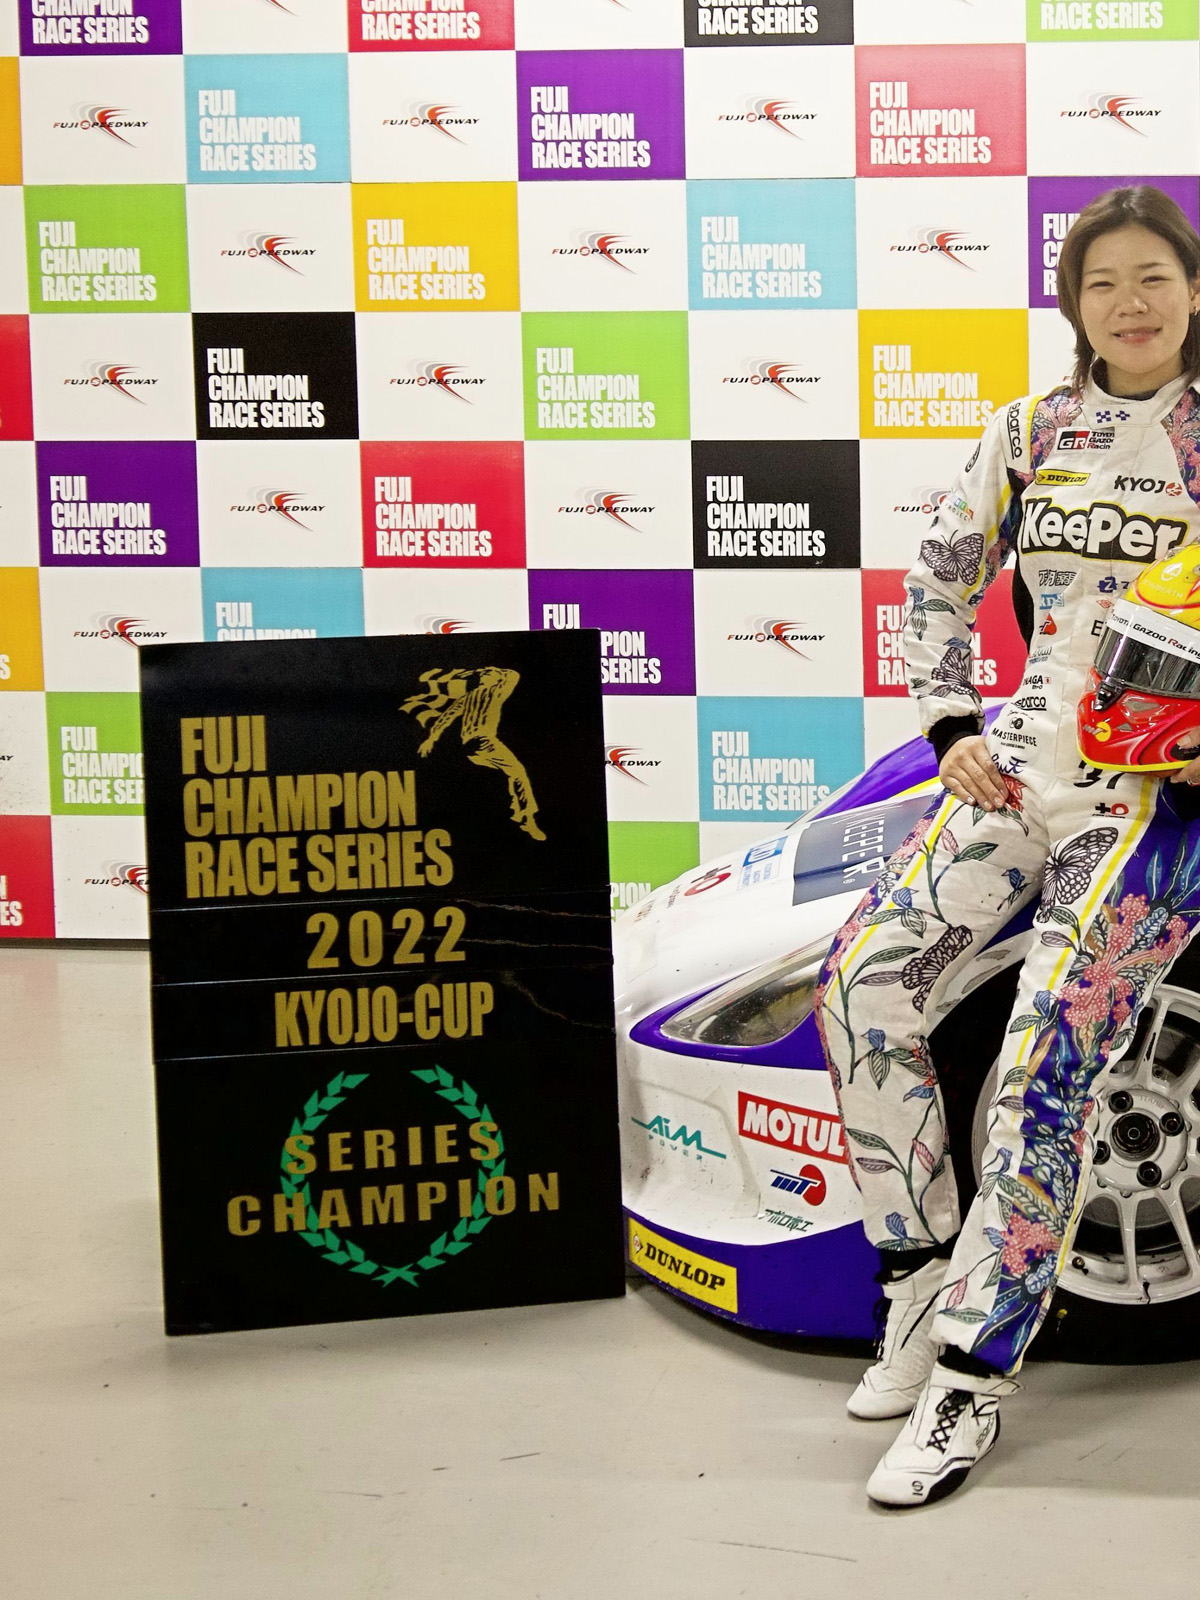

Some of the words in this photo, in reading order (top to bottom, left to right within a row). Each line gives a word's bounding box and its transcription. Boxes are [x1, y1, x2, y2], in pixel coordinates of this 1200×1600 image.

[530, 86, 567, 113] FUJI
[870, 82, 908, 109] FUJI
[530, 113, 634, 141] CHAMPION
[870, 109, 975, 137] CHAMPION
[531, 141, 582, 168] RACE
[584, 141, 650, 168] SERIES
[871, 137, 922, 164] RACE
[924, 137, 991, 164] SERIES
[39, 221, 75, 247] FUJI
[702, 216, 739, 243] FUJI
[39, 247, 140, 274] CHAMPION
[702, 243, 805, 271] CHAMPION
[40, 274, 89, 301] RACE
[91, 274, 156, 301] SERIES
[703, 271, 753, 298] RACE
[755, 271, 821, 298] SERIES
[207, 348, 243, 374] FUJI
[207, 374, 308, 401] CHAMPION
[208, 401, 257, 428] RACE
[259, 401, 324, 428] SERIES
[1008, 403, 1022, 460] sparco
[1059, 437, 1086, 449] GR
[374, 477, 411, 503] FUJI
[706, 476, 743, 502] FUJI
[1046, 474, 1088, 484] DUNLOP
[374, 503, 476, 530] CHAMPION
[706, 503, 810, 530] CHAMPION
[375, 530, 425, 557] RACE
[427, 530, 492, 557] SERIES
[707, 530, 758, 557] RACE
[760, 530, 826, 557] SERIES
[1021, 501, 1183, 561] KeePer
[1133, 623, 1168, 643] GAZOO
[181, 715, 266, 774] FUJI
[991, 727, 1038, 747] MASTERPIECE
[183, 771, 416, 837] CHAMPION
[185, 838, 299, 898] RACE
[305, 829, 453, 893] SERIES
[306, 907, 466, 969] 2022
[275, 982, 494, 1047] KYOJO-CUP
[743, 1100, 846, 1157] MOTUL
[285, 1121, 501, 1175] SERIES
[228, 1172, 559, 1237] CHAMPION
[644, 1242, 726, 1291] DUNLOP
